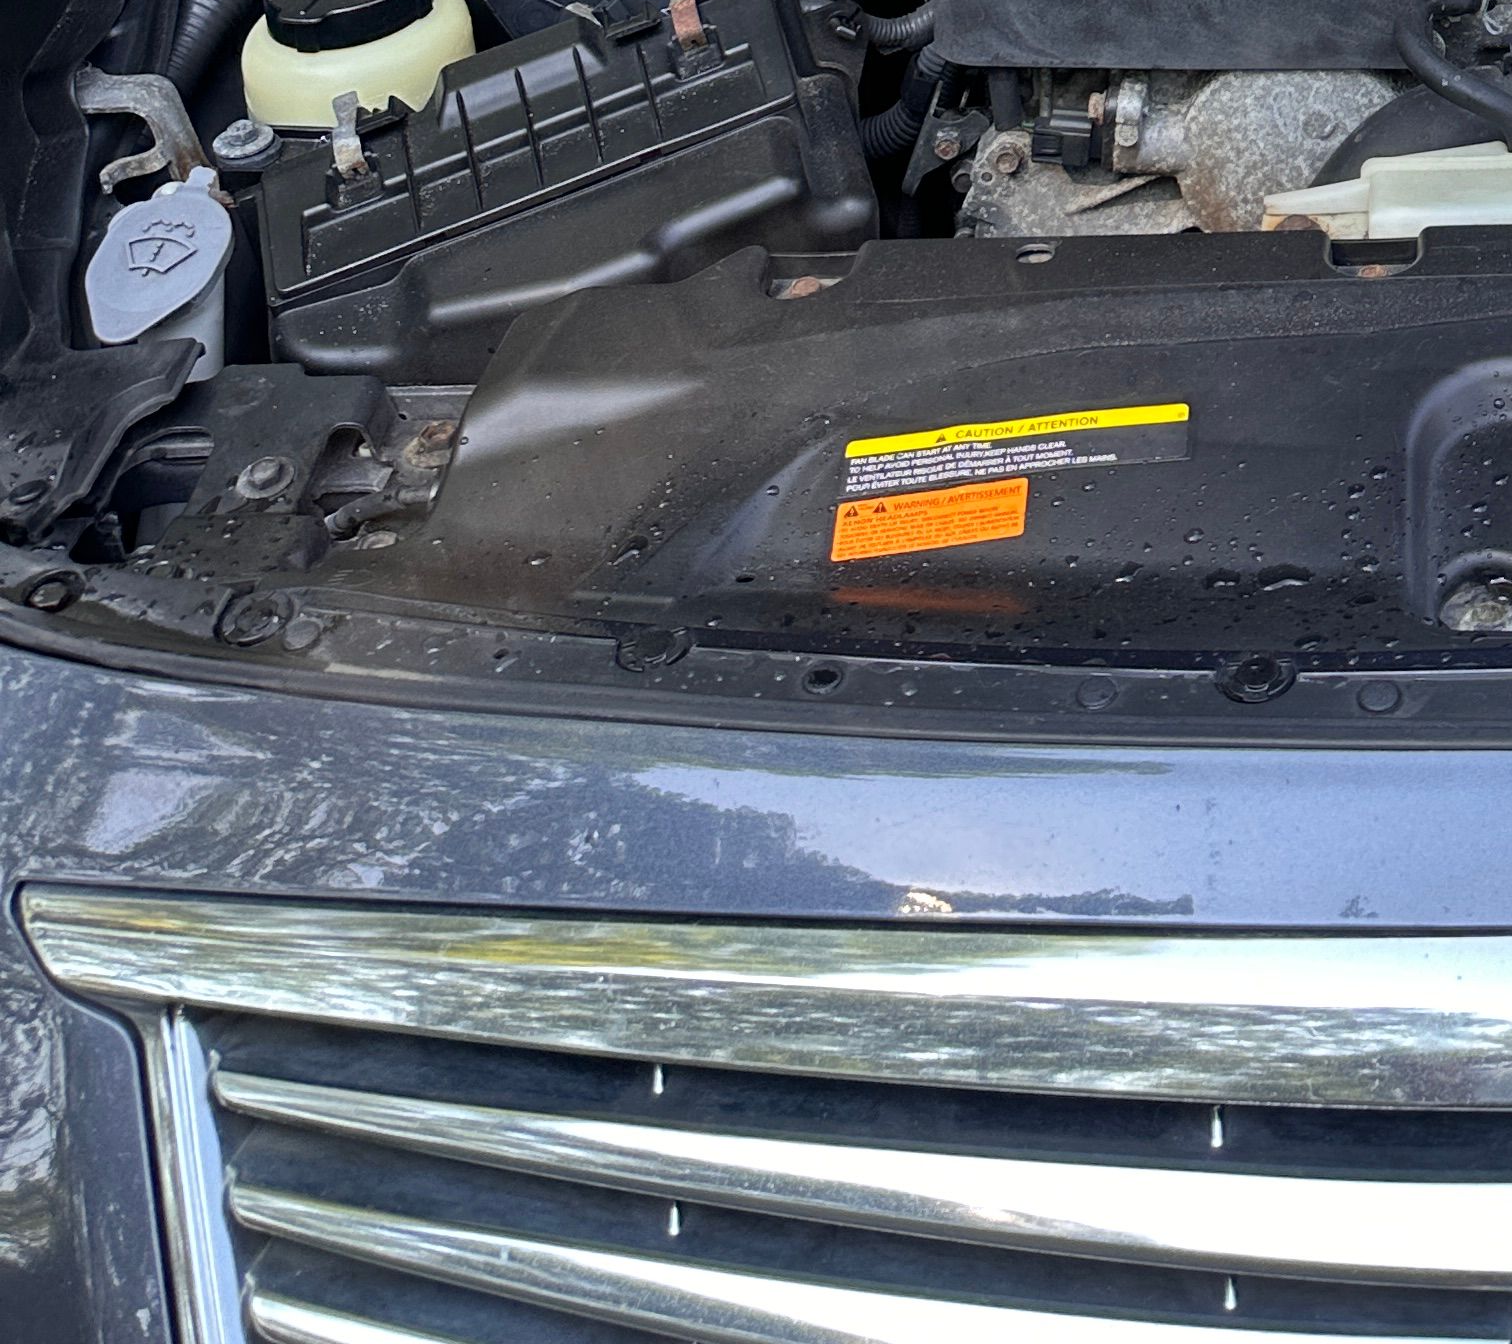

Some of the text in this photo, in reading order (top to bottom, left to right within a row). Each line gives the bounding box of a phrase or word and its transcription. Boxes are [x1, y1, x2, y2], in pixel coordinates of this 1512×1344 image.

[955, 426, 1014, 439] CAUTION
[1028, 416, 1099, 432] ATTENTION
[862, 463, 884, 472] HELP
[884, 461, 910, 470] AVOID
[911, 454, 954, 466] PERSONAL
[1007, 444, 1036, 453] HANDS
[868, 455, 895, 463] BLADE
[896, 452, 915, 460] CAN
[916, 448, 941, 457] START
[942, 445, 952, 453] AT
[953, 443, 970, 451] ANY
[846, 483, 870, 492] POUR
[901, 476, 927, 485] TOUTE
[974, 468, 987, 476] NE
[987, 466, 1005, 475] PAS
[1005, 464, 1018, 472] EN
[1071, 456, 1088, 464] LES
[847, 476, 857, 484] LE
[859, 470, 912, 482] VENTILATEUR
[1013, 453, 1034, 462] TOUT
[894, 498, 939, 510] WARNING
[948, 486, 1022, 502] AVERTISSEMENT
